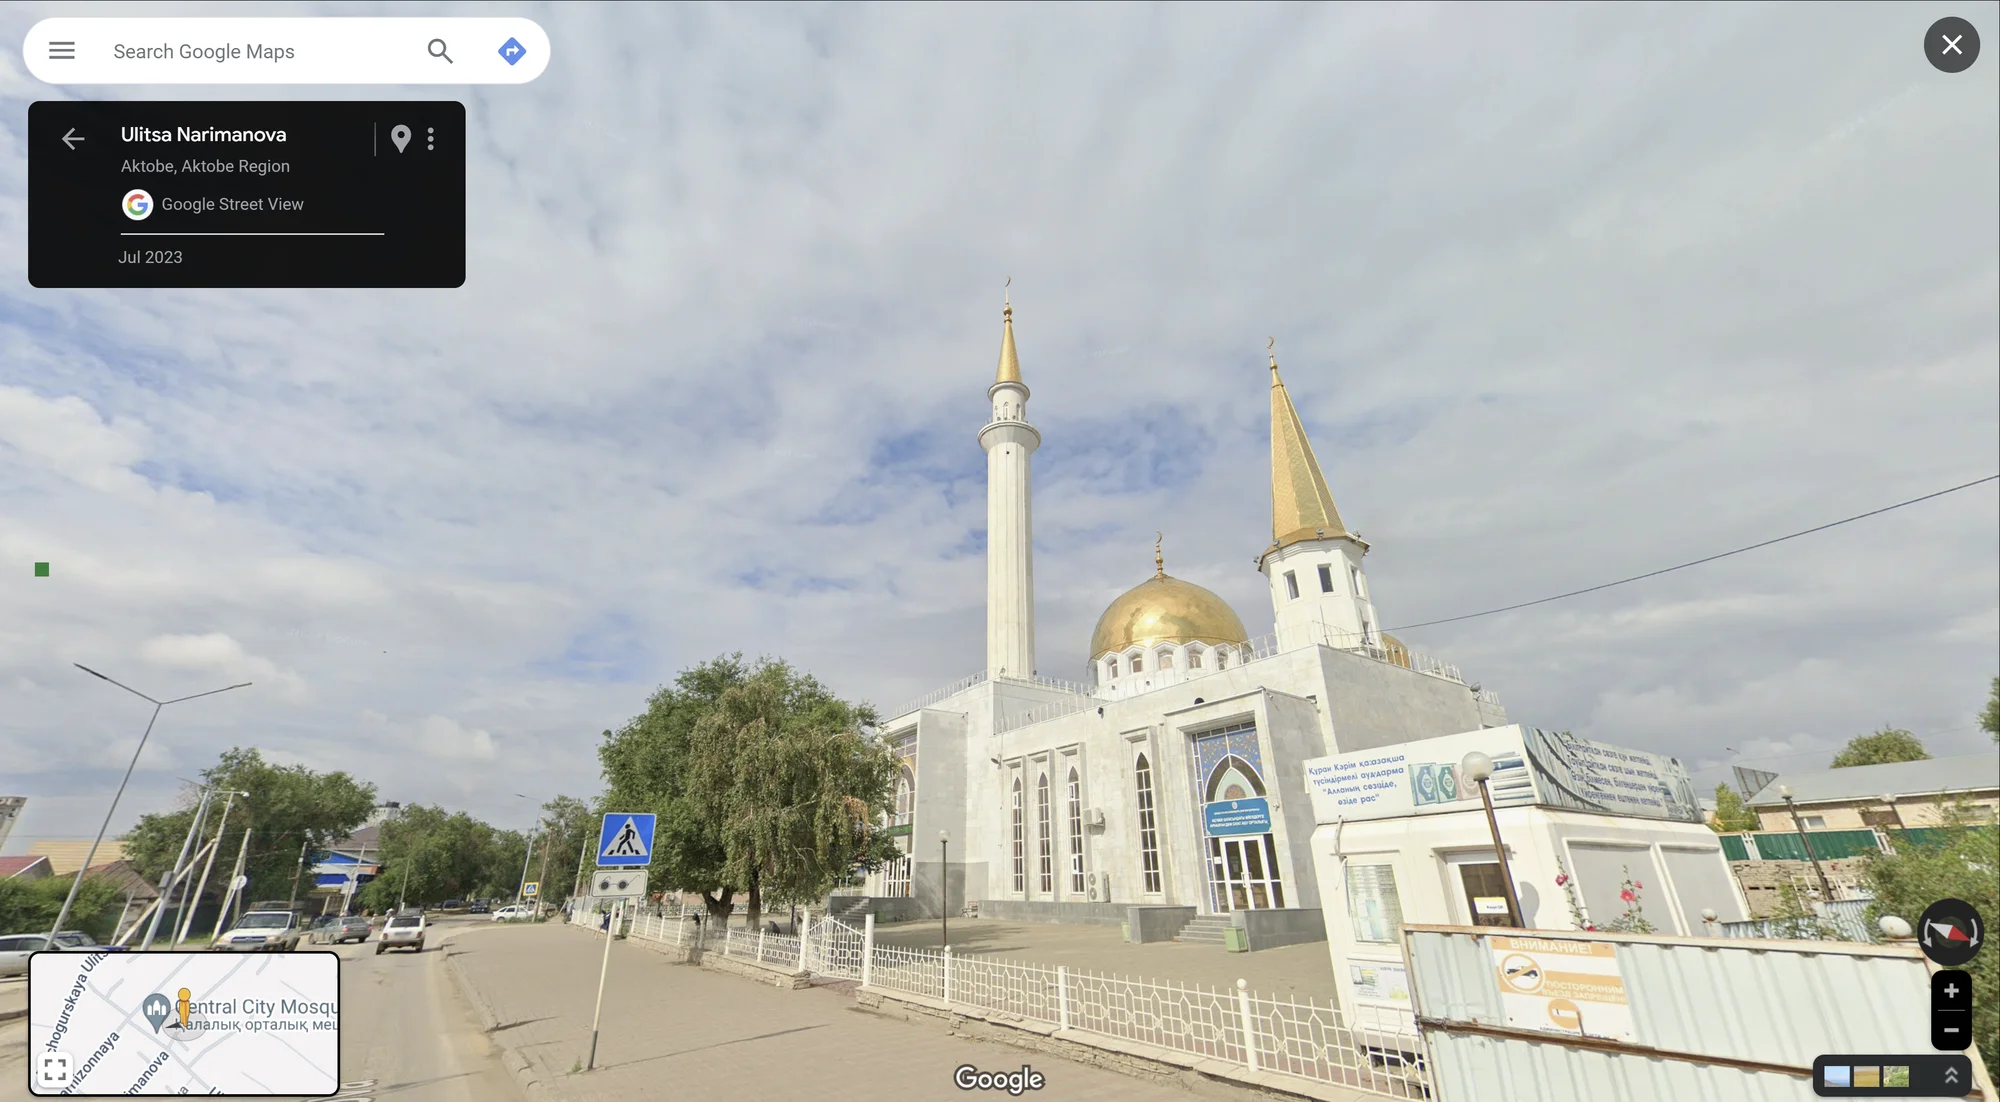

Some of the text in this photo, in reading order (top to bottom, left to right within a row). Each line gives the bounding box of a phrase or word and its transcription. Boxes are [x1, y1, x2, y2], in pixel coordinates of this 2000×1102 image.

[1334, 762, 1357, 771] Кәрім
[1313, 772, 1358, 787] түсіндірмелі
[1338, 797, 1358, 806] өзіде
[1509, 938, 1593, 955] ВНИМАНИЕ!
[1546, 980, 1624, 994] ПОСТОРОННИМ
